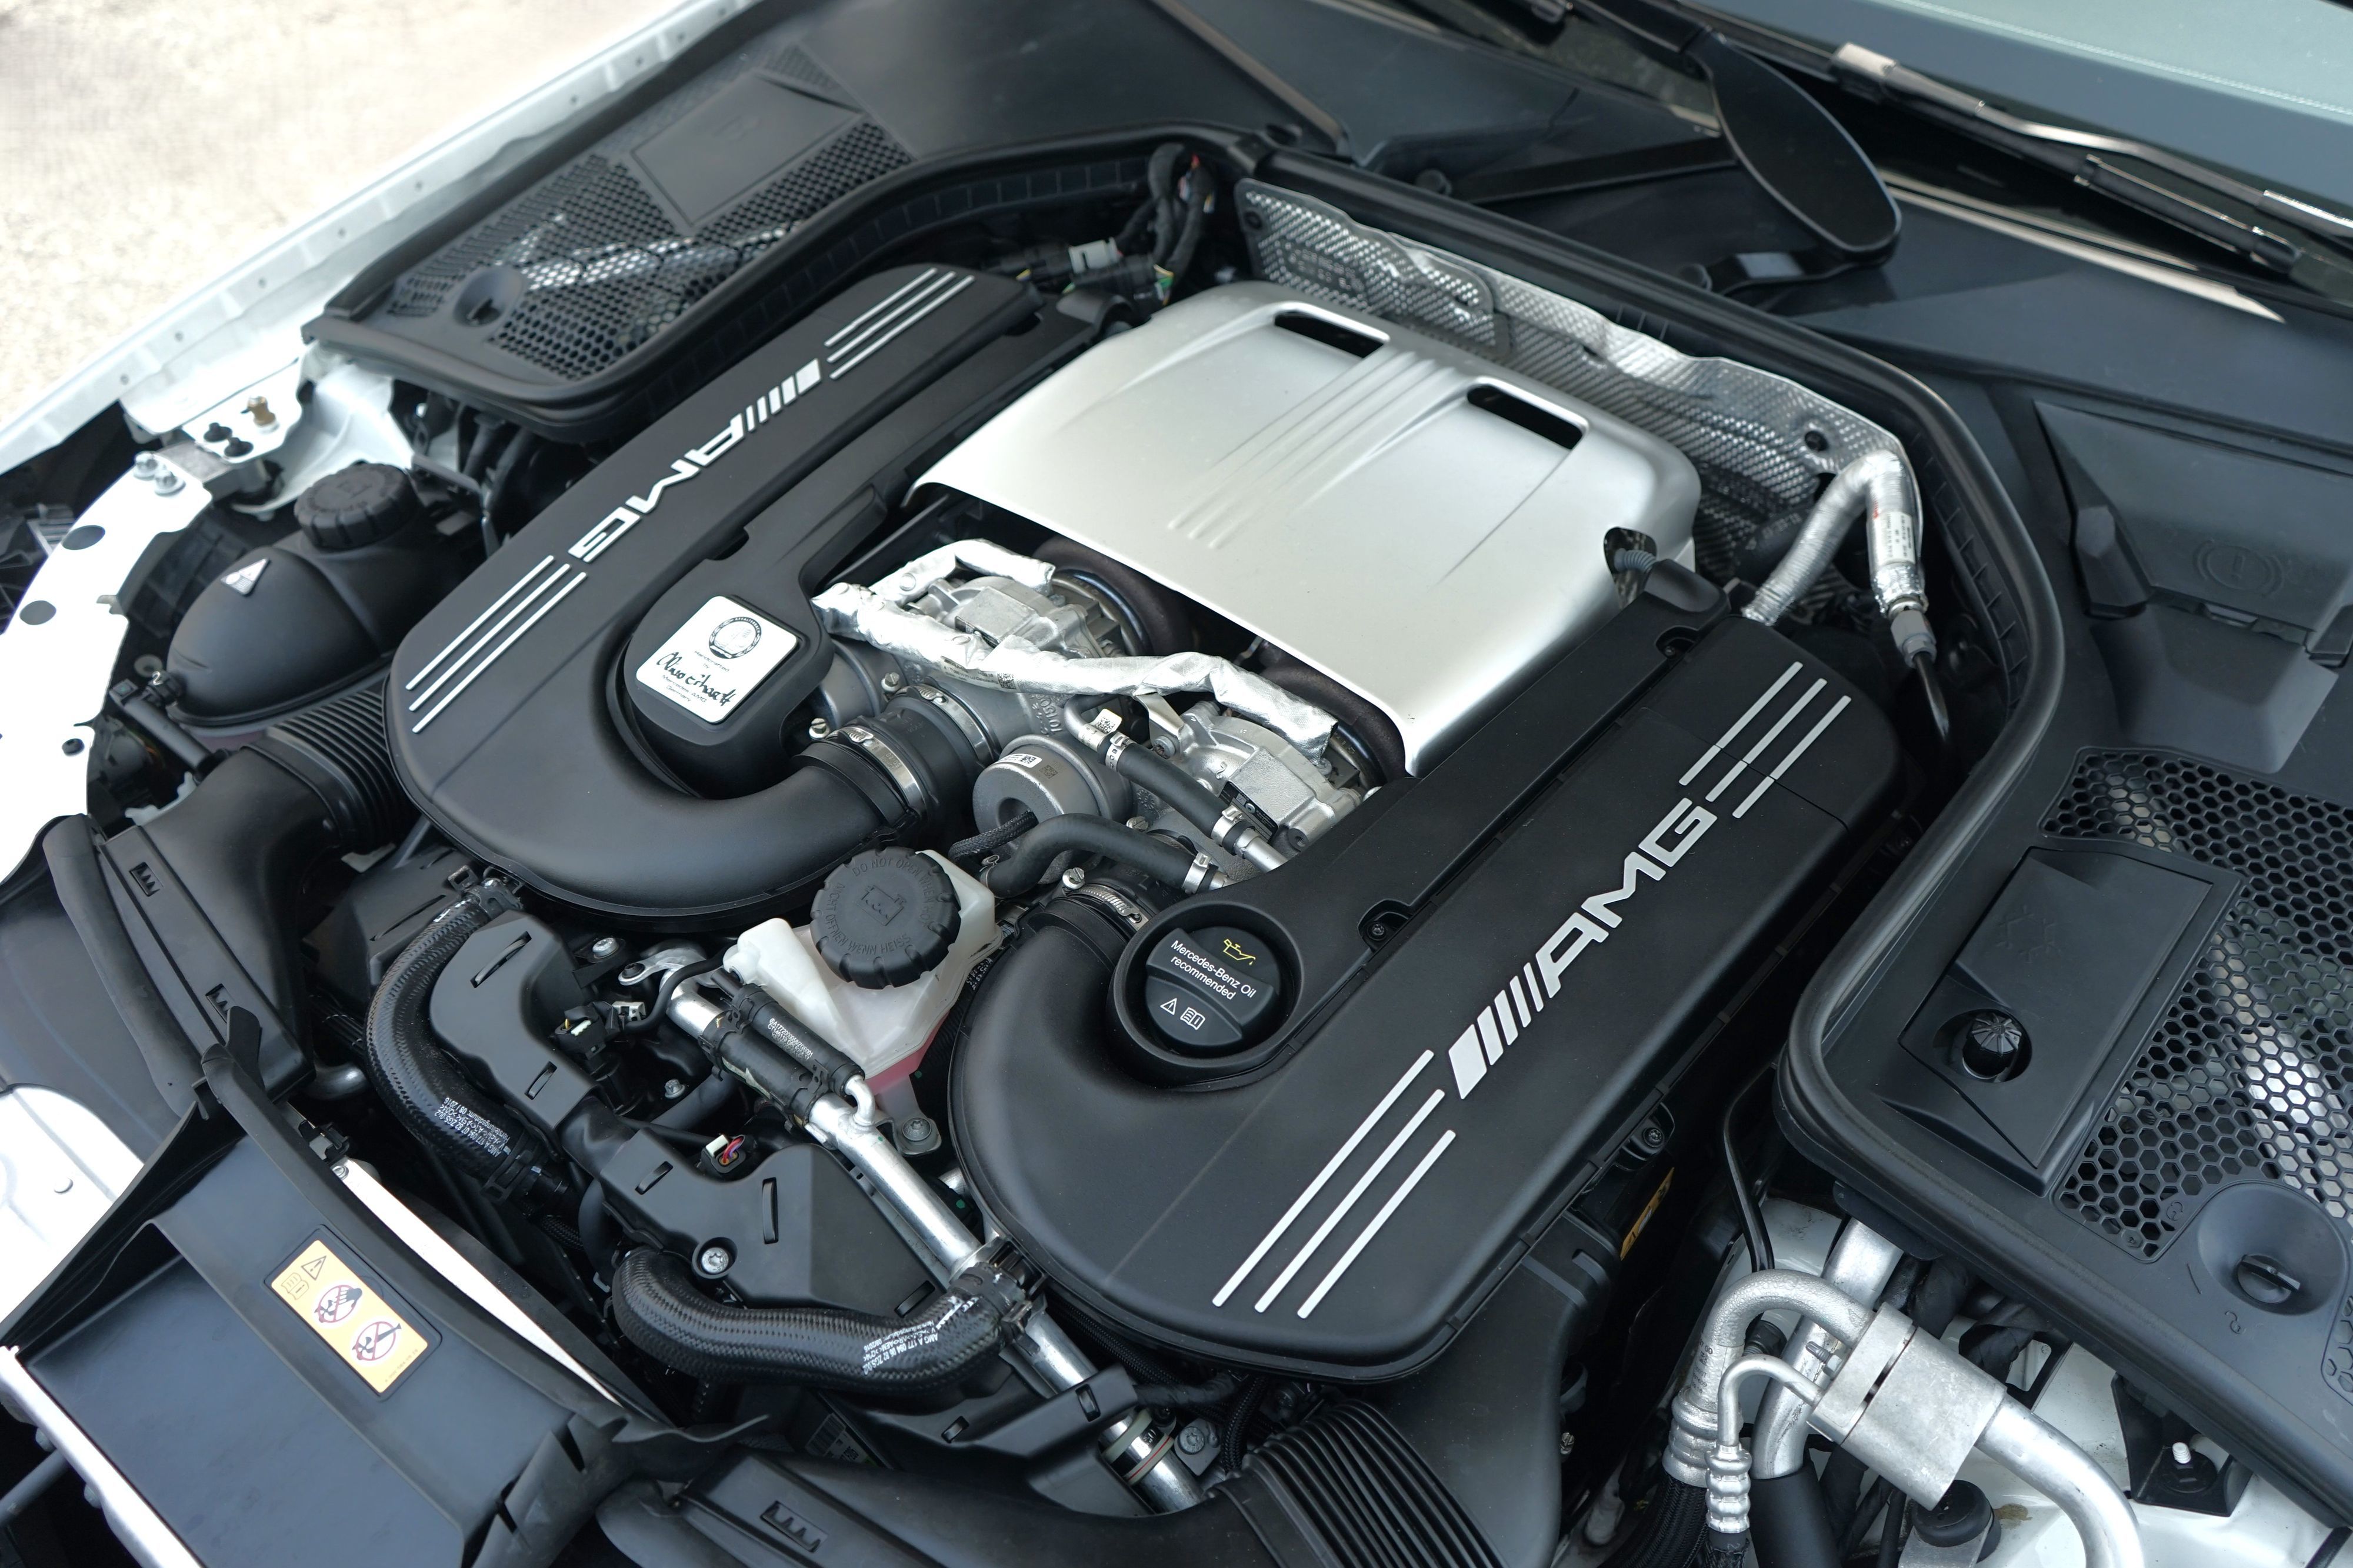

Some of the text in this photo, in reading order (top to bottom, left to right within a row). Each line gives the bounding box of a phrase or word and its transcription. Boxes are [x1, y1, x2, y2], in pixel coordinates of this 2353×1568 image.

[568, 413, 744, 562] AMG
[666, 685, 692, 702] Germany
[852, 863, 868, 877] DO
[872, 858, 892, 869] NOT
[896, 859, 922, 877] OPEN
[919, 876, 934, 903] WHEN
[1535, 798, 1718, 999] AMG
[848, 942, 876, 955] WENN
[1171, 940, 1257, 999] Mercedes-Benz Oil
[1171, 956, 1236, 1000] recommended
[444, 1097, 458, 1109] 2016
[459, 1106, 468, 1115] 08
[455, 1122, 464, 1130] 82
[461, 1126, 470, 1135] 07
[475, 1136, 486, 1146] 177
[487, 1145, 502, 1157] AMG
[908, 1340, 918, 1349] 177
[924, 1333, 938, 1344] AMG
